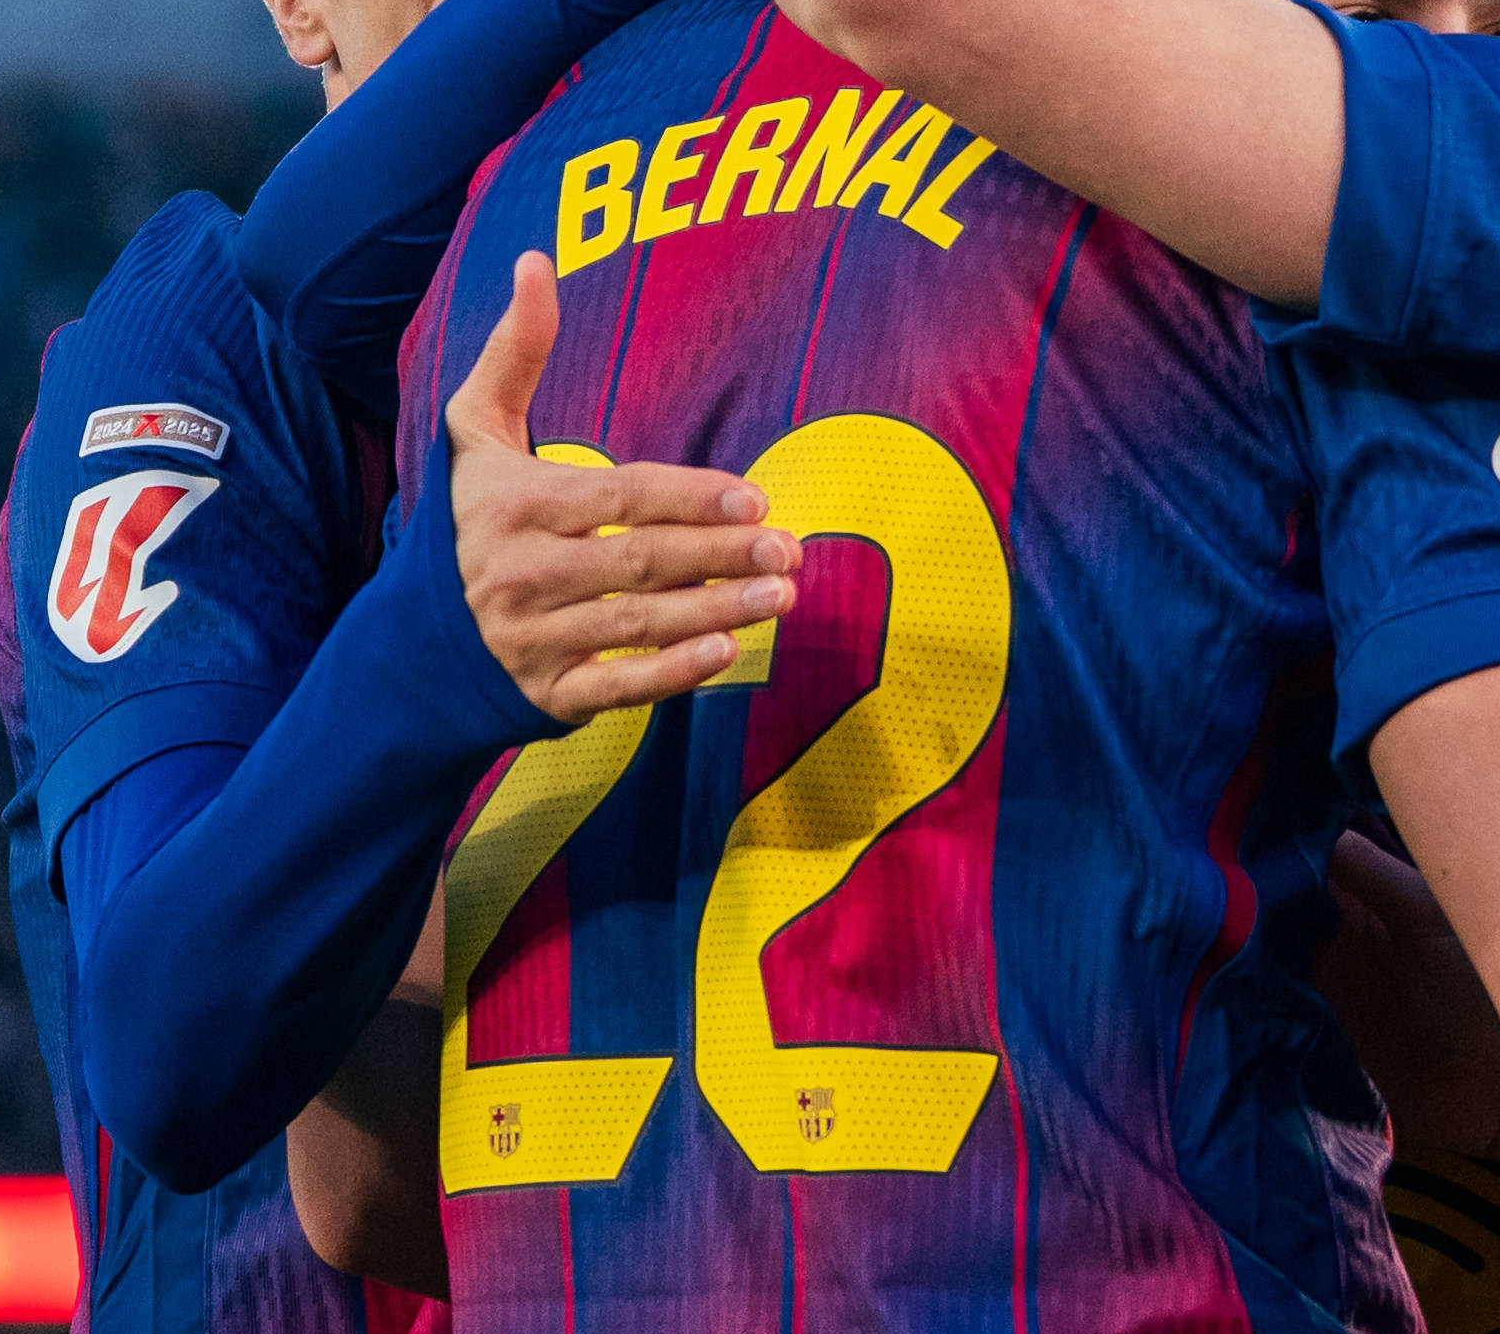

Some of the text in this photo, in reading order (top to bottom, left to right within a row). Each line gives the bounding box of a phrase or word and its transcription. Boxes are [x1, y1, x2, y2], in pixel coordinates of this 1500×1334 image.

[556, 87, 998, 279] BERNAL
[91, 417, 216, 442] 2024 2025
[439, 412, 1012, 1195] 22
